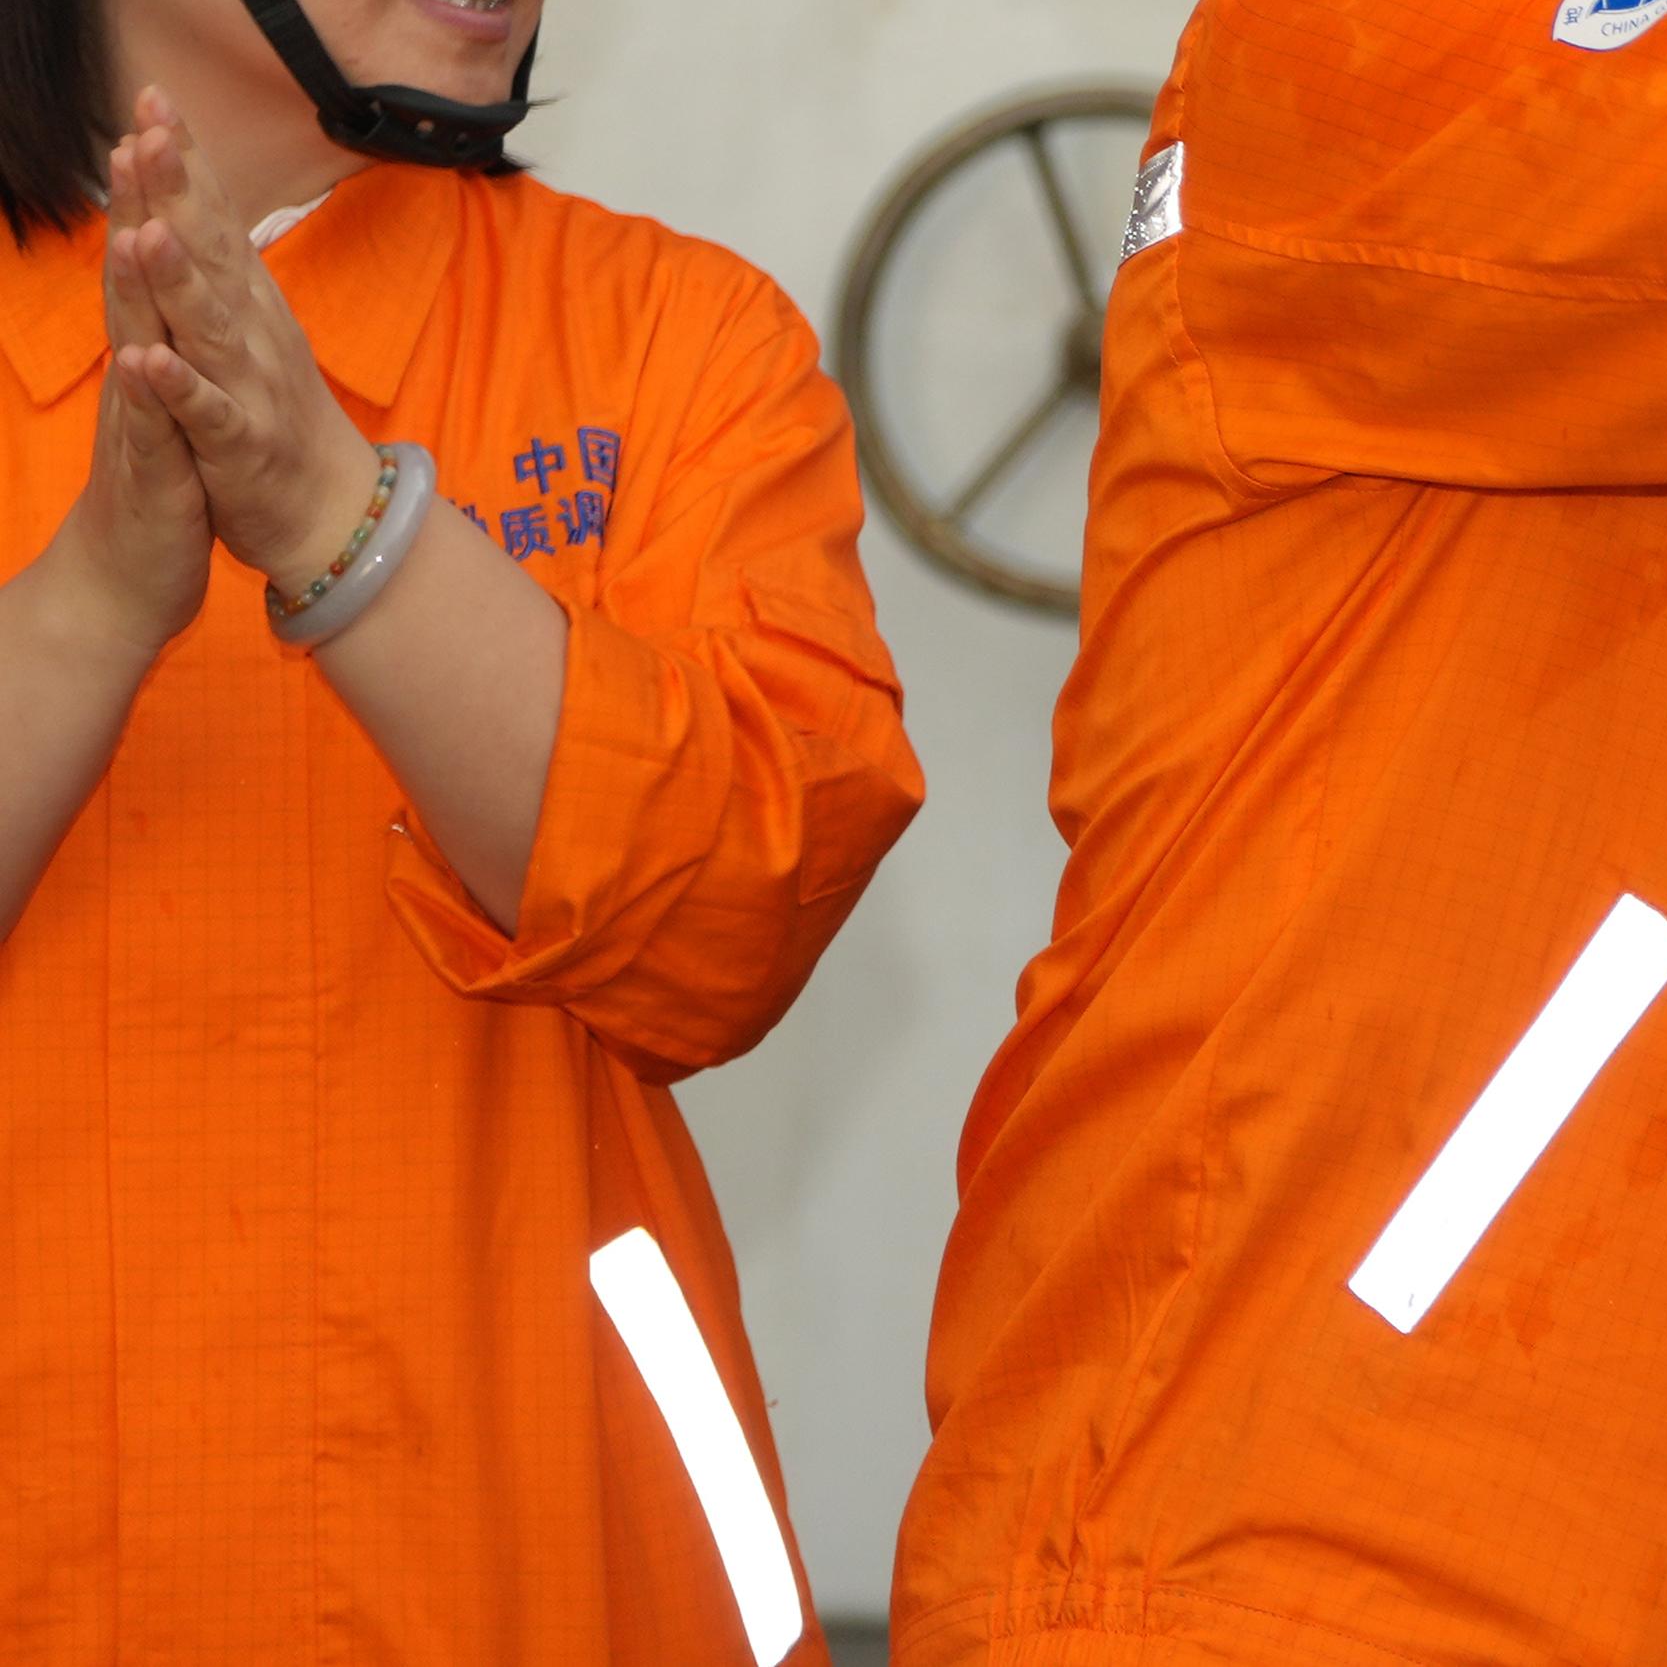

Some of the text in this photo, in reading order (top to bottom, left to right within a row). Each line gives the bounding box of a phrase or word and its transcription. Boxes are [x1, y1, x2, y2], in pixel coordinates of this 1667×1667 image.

[1600, 13, 1650, 37] CHINA
[513, 425, 621, 495] 中国
[449, 490, 607, 563] 质调
